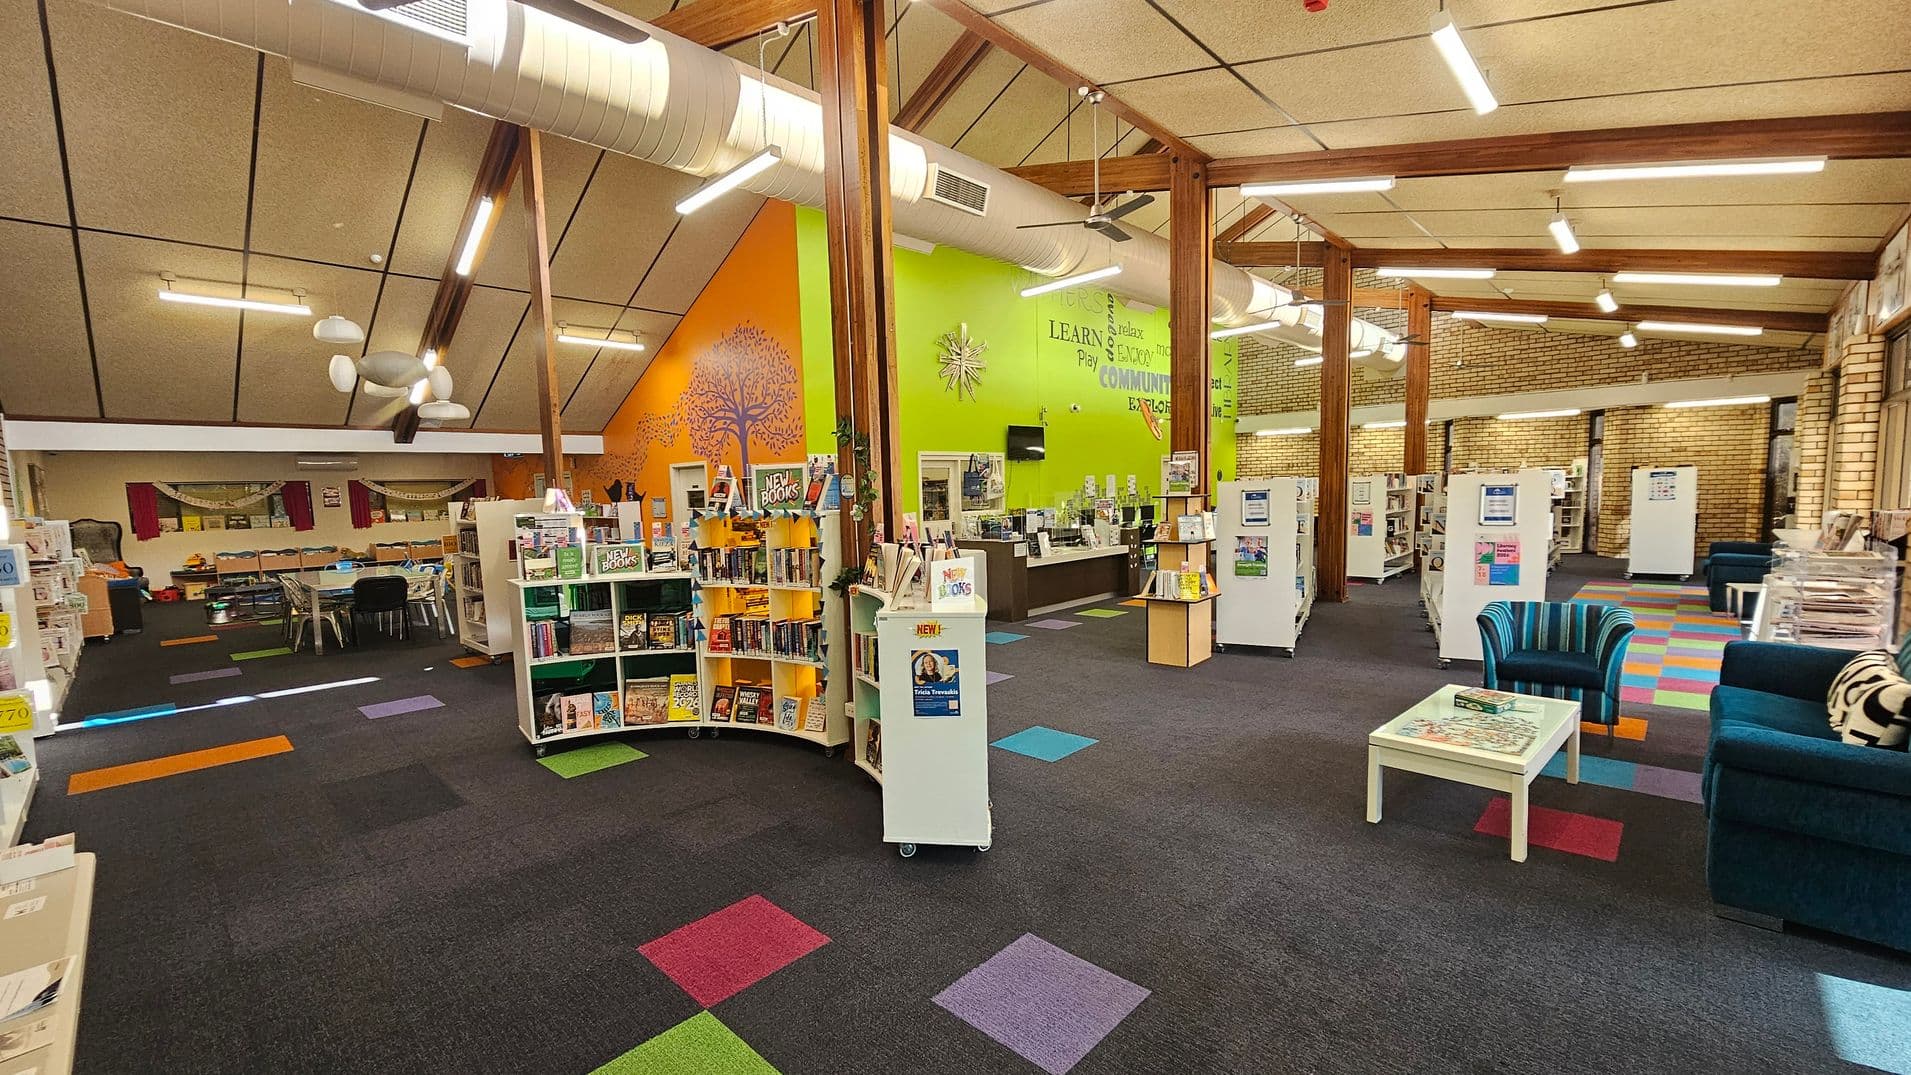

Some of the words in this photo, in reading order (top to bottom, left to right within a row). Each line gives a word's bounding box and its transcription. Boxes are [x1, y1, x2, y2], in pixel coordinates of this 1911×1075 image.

[1048, 319, 1103, 348] LEARN
[1118, 321, 1144, 339] relax
[1077, 349, 1098, 372] Play
[1099, 365, 1171, 395] COMMUNIT
[764, 470, 790, 490] NEW
[760, 483, 800, 508] BOOKS
[602, 555, 638, 572] BOOKS
[606, 548, 630, 561] NEW
[943, 567, 967, 582] NEW
[938, 582, 972, 599] BOOKS
[0, 707, 29, 721] 70
